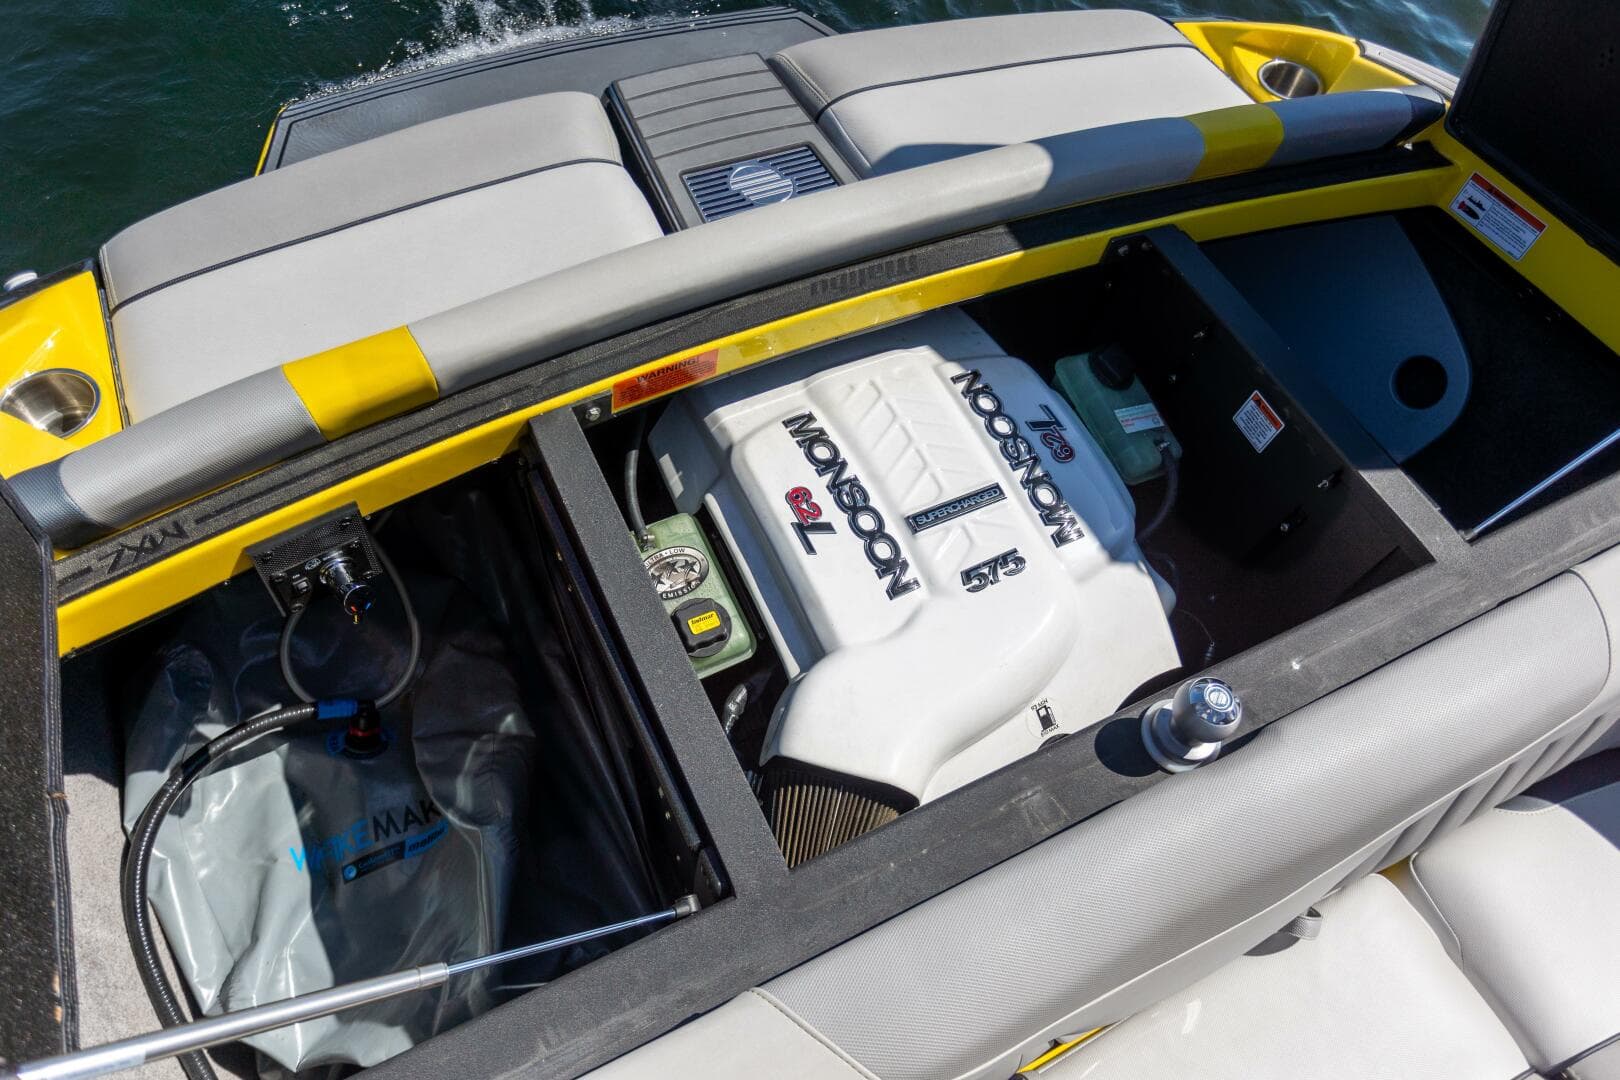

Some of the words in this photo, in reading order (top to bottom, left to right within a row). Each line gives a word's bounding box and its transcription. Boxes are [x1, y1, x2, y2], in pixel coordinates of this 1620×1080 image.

[781, 411, 921, 601] MONSOON
[915, 486, 1002, 527] SUPERCHARGED
[950, 369, 1086, 548] MONSOON
[960, 547, 1027, 593] 575
